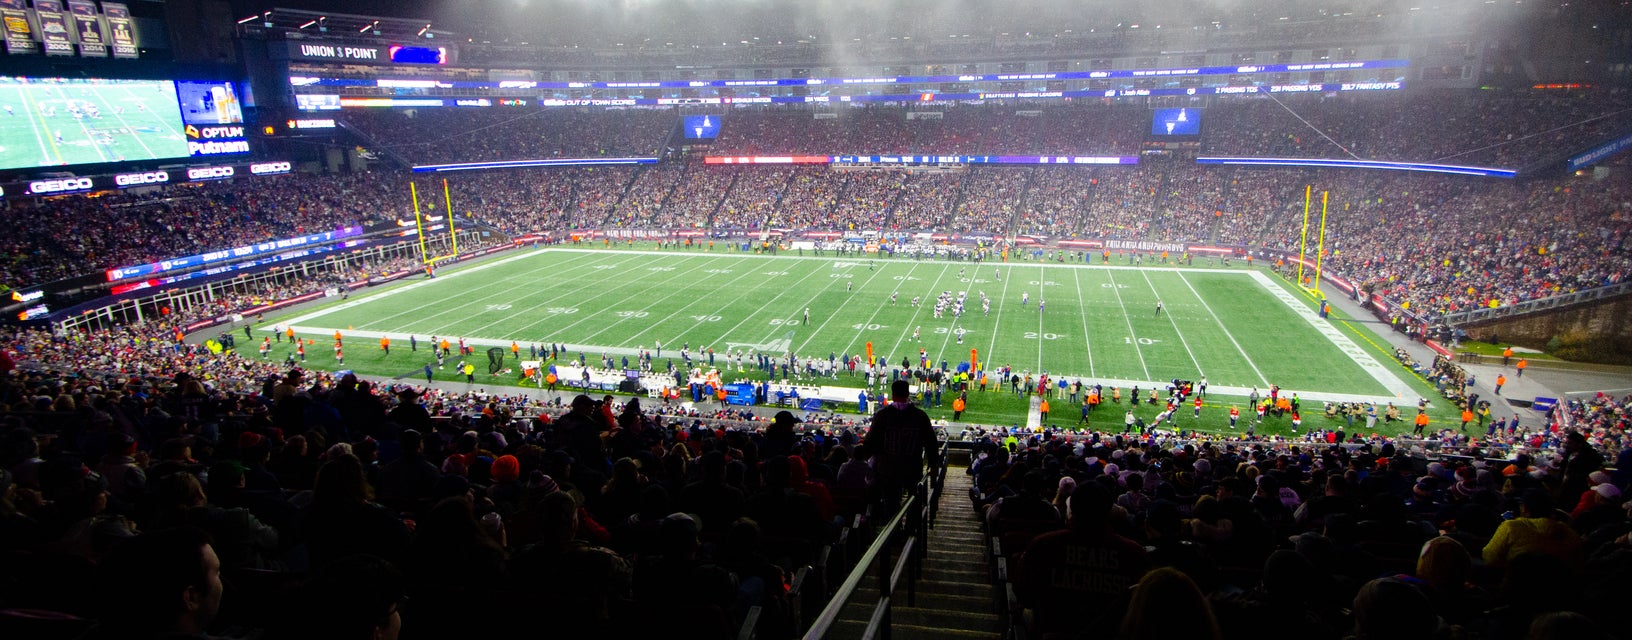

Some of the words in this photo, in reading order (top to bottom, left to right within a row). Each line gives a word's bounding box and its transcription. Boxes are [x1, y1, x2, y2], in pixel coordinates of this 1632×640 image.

[84, 44, 104, 52] 2014
[117, 46, 136, 54] 2016
[301, 44, 335, 57] UNION
[345, 47, 377, 60] POINT
[1356, 82, 1386, 90] FANTASY
[202, 126, 243, 138] OPTUM
[188, 140, 249, 155] Putnam
[1574, 154, 1591, 165] BUD
[1592, 143, 1617, 158] LIGHT
[188, 166, 234, 179] GEICO
[250, 162, 291, 174] GEICO
[115, 171, 169, 186] GEICO
[30, 177, 93, 193] GEICO
[325, 232, 331, 240] 7
[161, 260, 171, 270] 10
[113, 269, 123, 279] 10
[617, 311, 650, 319] 30
[768, 318, 800, 326] 50
[852, 323, 881, 331] 40
[934, 327, 967, 335] 30
[1024, 332, 1057, 340] 20
[1124, 336, 1153, 345] 10
[1065, 544, 1119, 571] BEARS
[1050, 567, 1132, 596] LACROSSE
